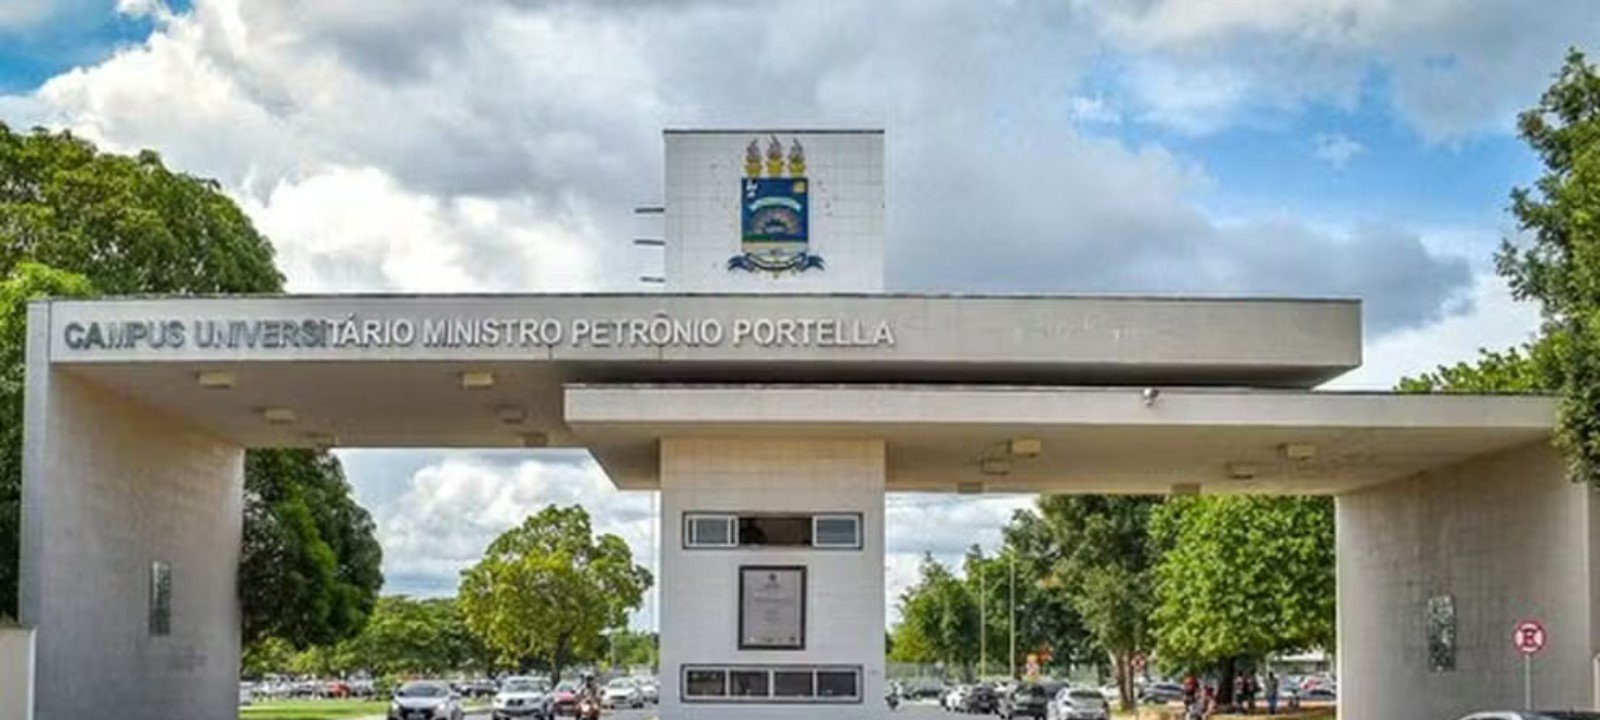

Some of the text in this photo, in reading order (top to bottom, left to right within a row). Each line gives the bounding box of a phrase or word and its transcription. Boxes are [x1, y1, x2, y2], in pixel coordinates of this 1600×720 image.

[64, 312, 896, 349] CAMPUS UNIVERSITÁRIO MINISTRO PETRÔNIO PORTELLA
